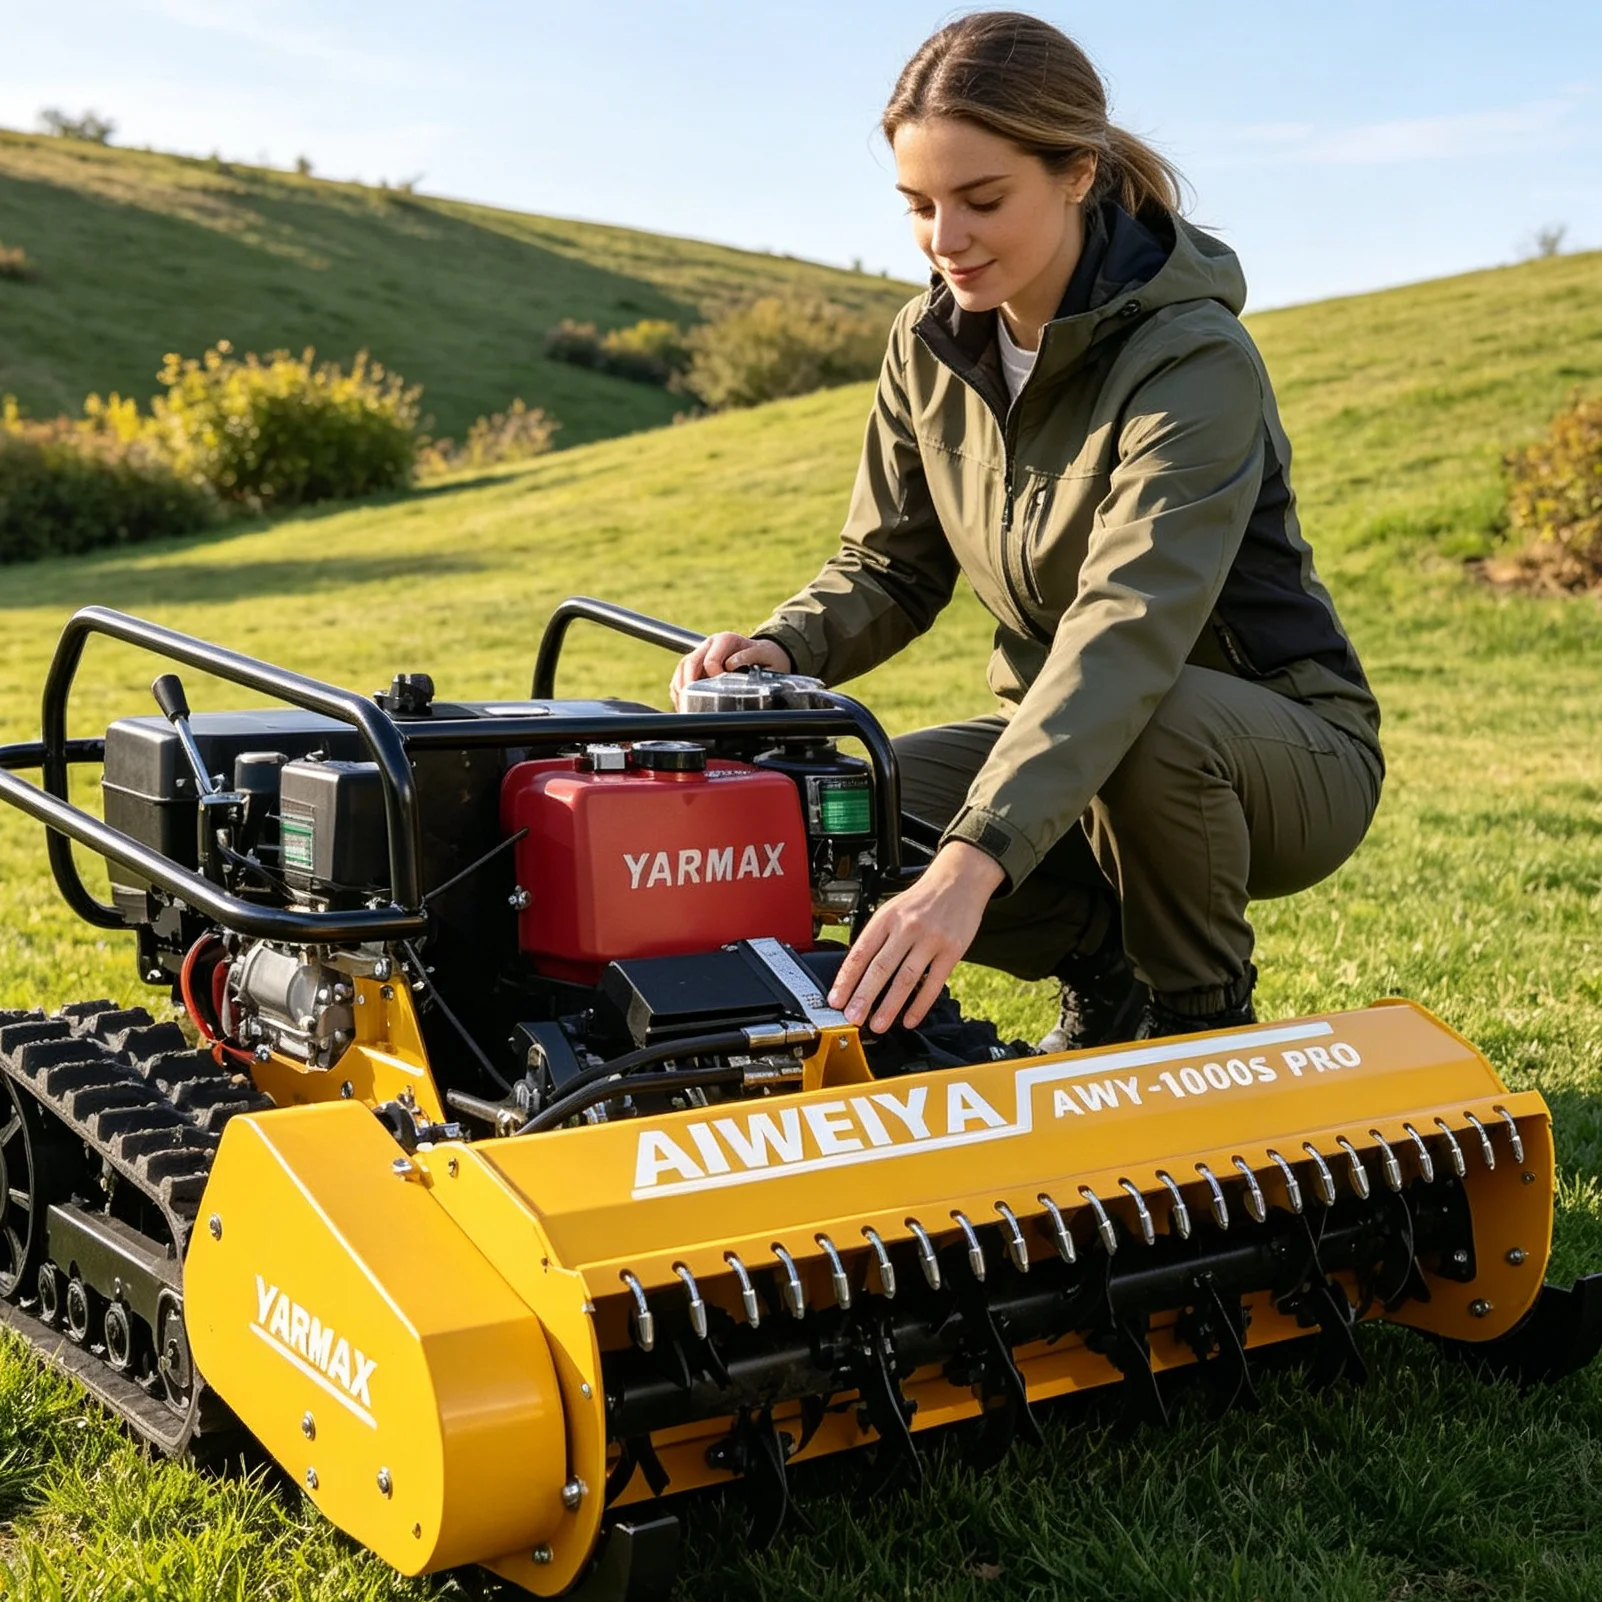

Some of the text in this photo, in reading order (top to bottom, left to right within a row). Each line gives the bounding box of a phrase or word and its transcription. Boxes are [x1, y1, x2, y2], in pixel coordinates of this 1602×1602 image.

[622, 842, 785, 890] YARMAX
[1281, 1042, 1362, 1077] PRO
[633, 1081, 1008, 1188] AIWEIYA
[255, 1273, 378, 1409] YARMAX
